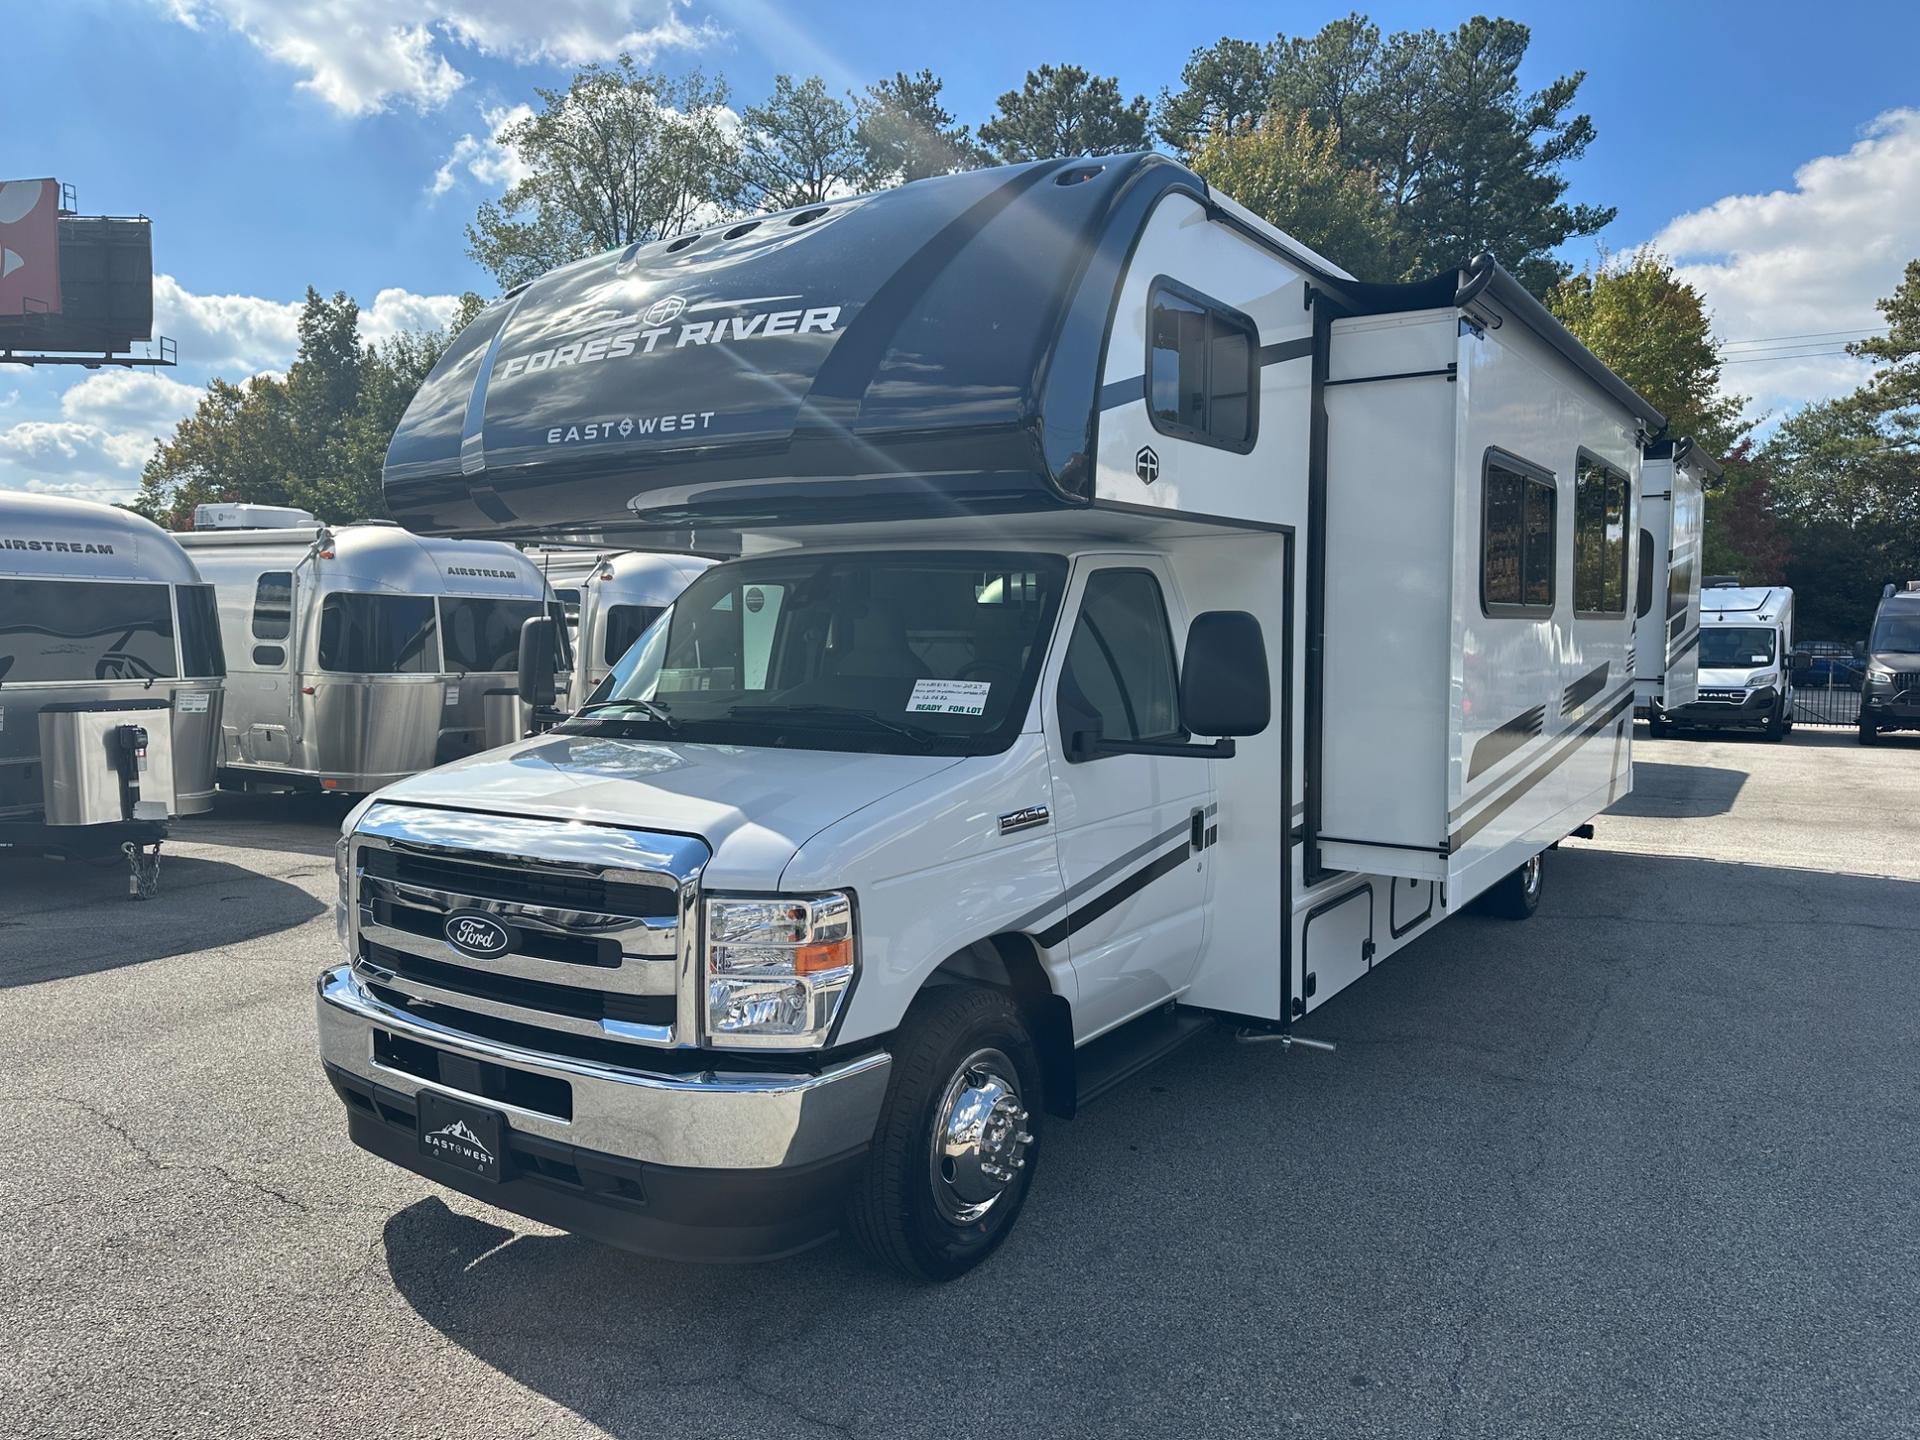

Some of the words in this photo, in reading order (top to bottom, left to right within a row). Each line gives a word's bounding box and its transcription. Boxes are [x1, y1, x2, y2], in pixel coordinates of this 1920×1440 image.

[501, 327, 671, 380] FOREST
[675, 306, 842, 348] RIVER
[547, 422, 615, 443] EAST
[638, 411, 715, 435] WEST
[447, 566, 516, 579] AIRSTREAM
[915, 703, 942, 711] READY
[947, 705, 965, 713] FOR
[966, 706, 982, 714] LOT
[457, 920, 494, 947] Ford
[425, 1134, 455, 1151] EAST
[463, 1147, 494, 1164] WEST
